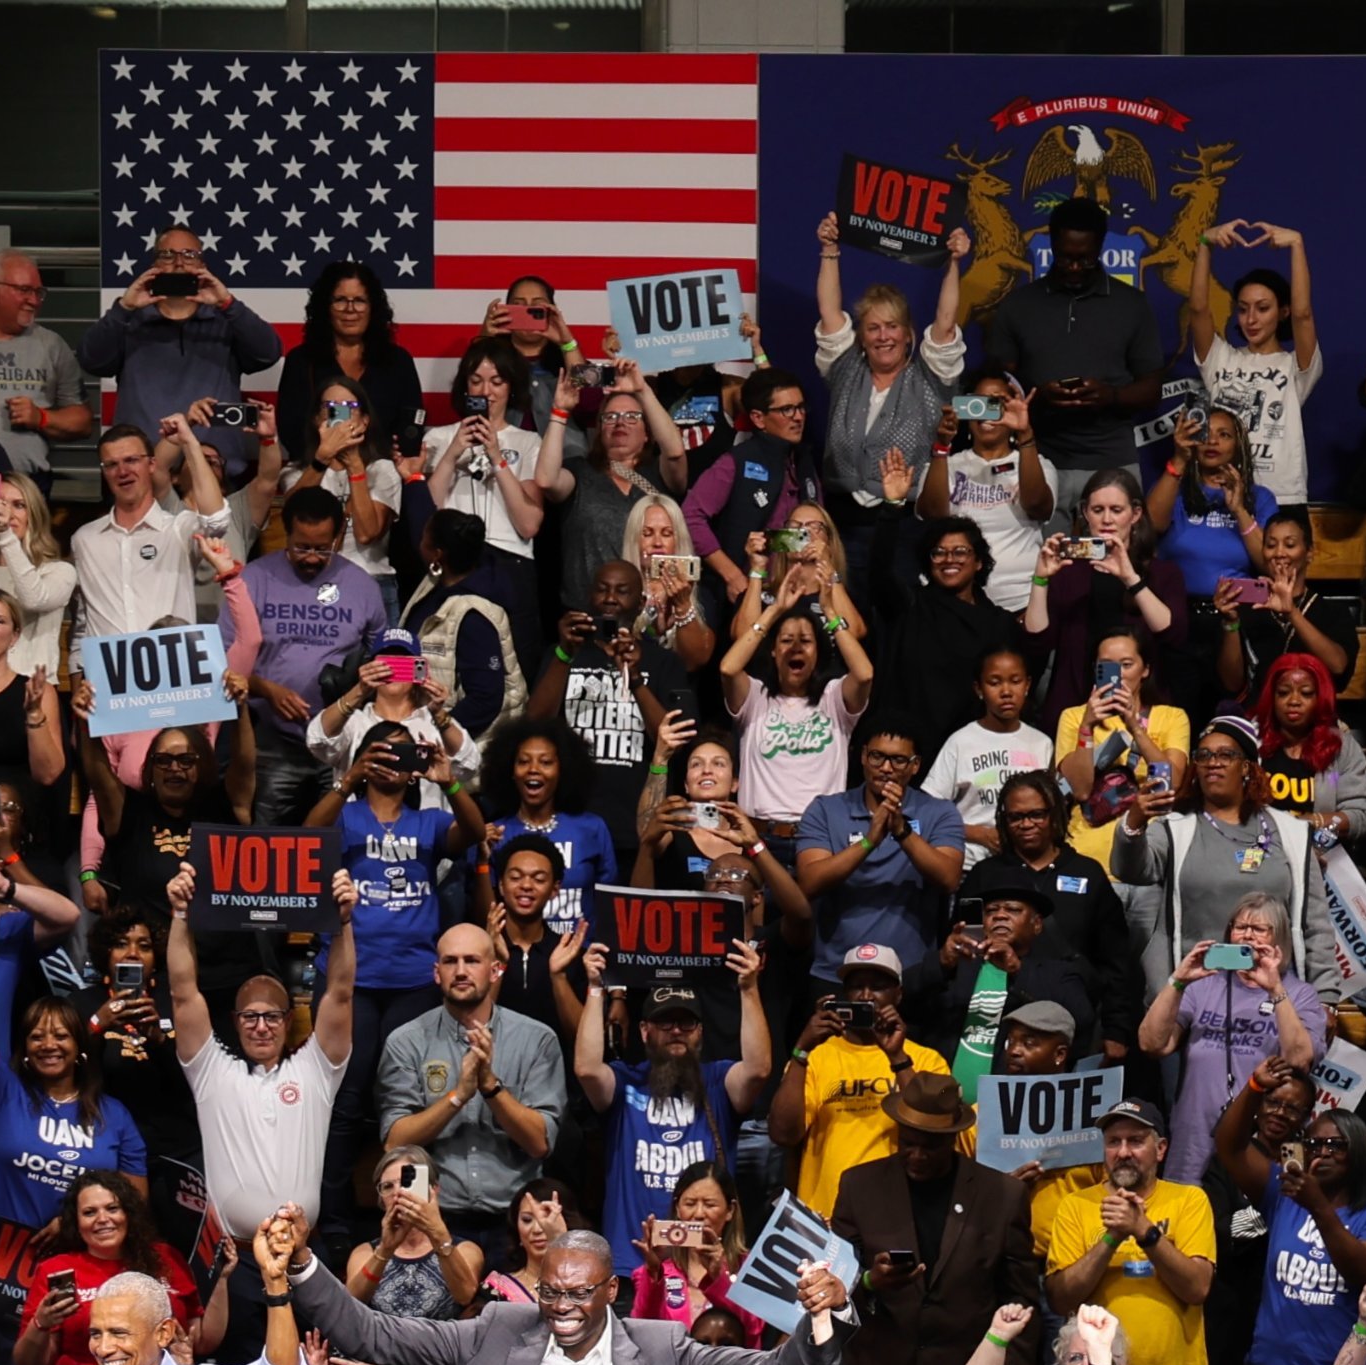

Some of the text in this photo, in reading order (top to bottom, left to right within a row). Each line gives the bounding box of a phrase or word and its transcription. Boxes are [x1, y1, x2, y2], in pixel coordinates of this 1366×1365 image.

[1018, 97, 1160, 124] E PLURIBUS UNUM
[855, 161, 953, 235] VOTE
[849, 216, 864, 229] BY
[865, 219, 929, 245] NOVEMBER
[627, 275, 730, 335] VOTE
[635, 337, 658, 349] BY
[661, 331, 718, 348] NOVEMBER
[264, 604, 352, 623] BENSON
[275, 623, 340, 638] BRINKS
[100, 630, 213, 695] VOTE
[109, 687, 212, 710] BY NOVEMBER 3
[573, 726, 644, 763] ATTER
[762, 731, 832, 758] Polls
[972, 750, 1009, 772] BRING
[367, 834, 418, 863] UAW
[209, 834, 323, 894] VOTE
[211, 894, 318, 909] BY NOVEMBER 3
[613, 897, 726, 955] VOTE
[617, 953, 635, 967] BY
[636, 954, 712, 969] NOVEMBER
[998, 1076, 1103, 1135] VOTE
[38, 1114, 94, 1149] UAW
[1000, 1138, 1021, 1149] BY
[1022, 1133, 1090, 1149] NOVEMBER
[1299, 1291, 1336, 1306] SENATE
